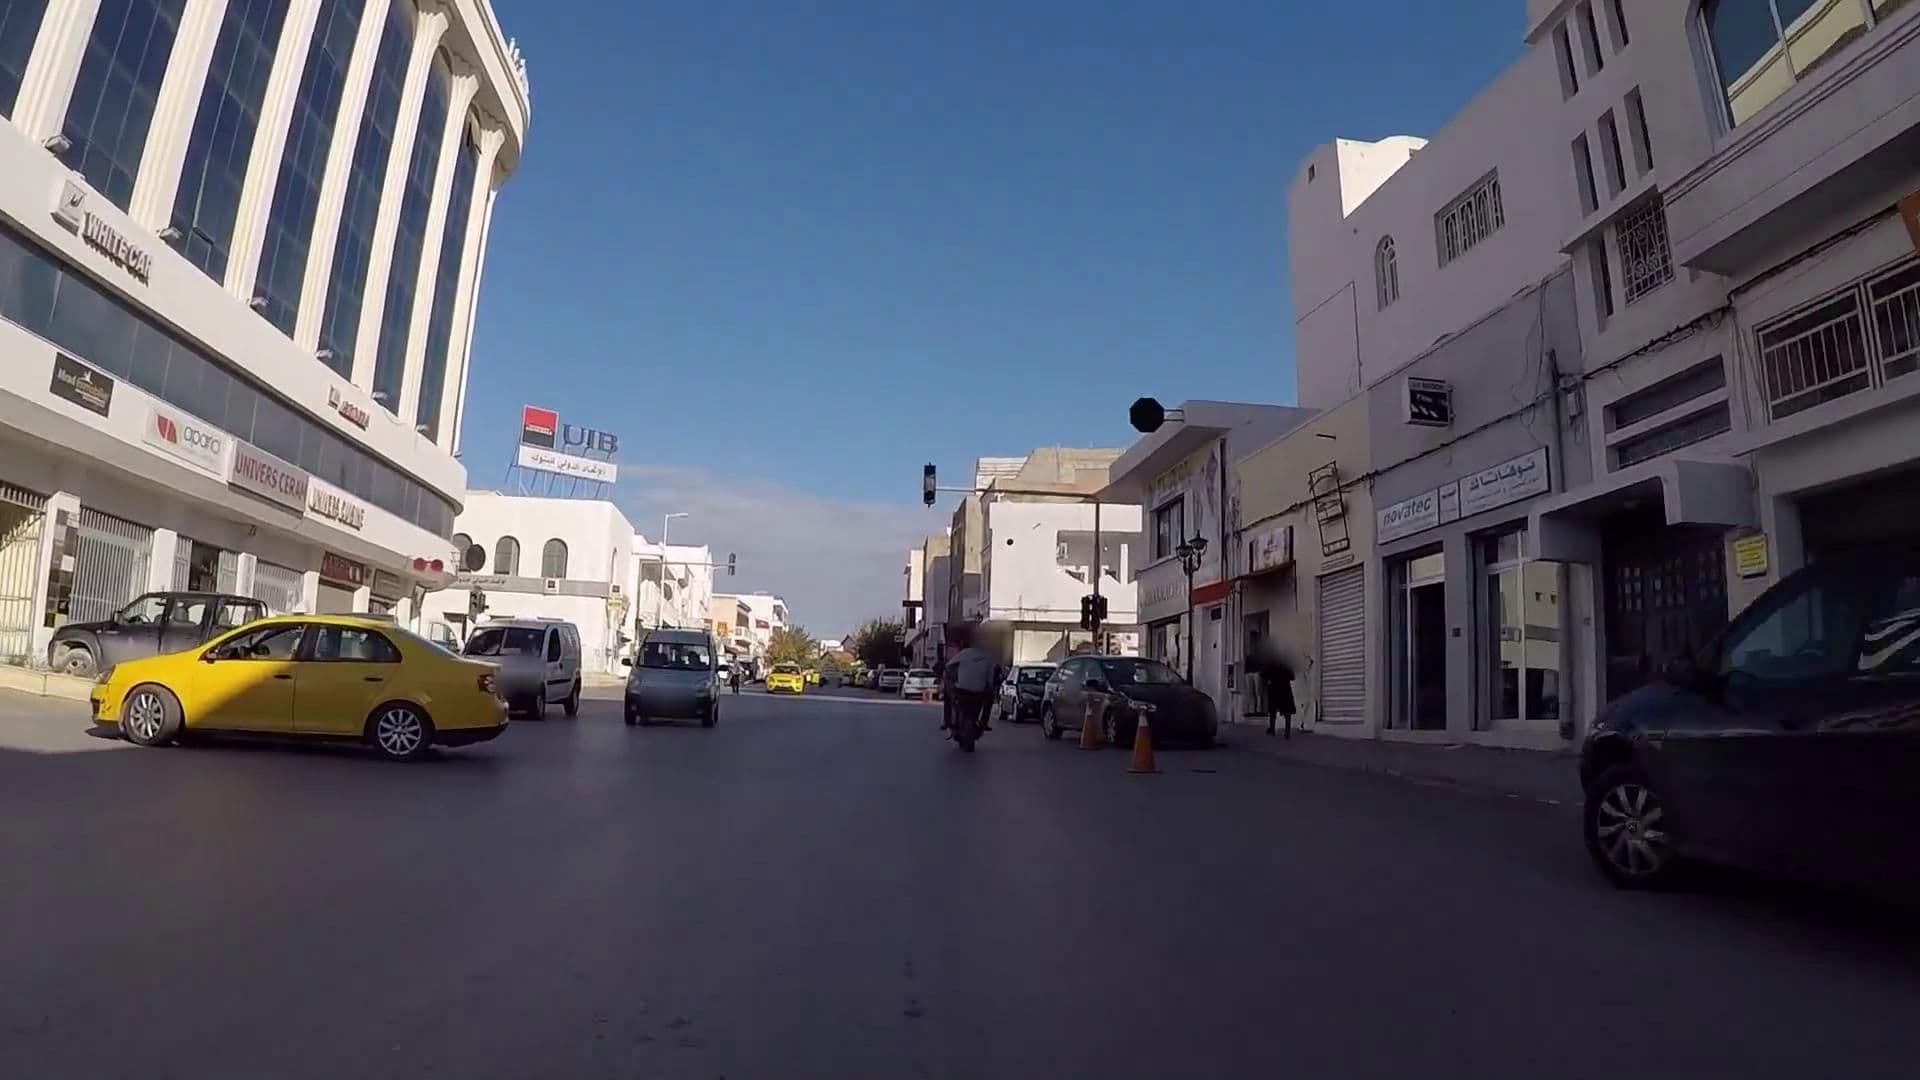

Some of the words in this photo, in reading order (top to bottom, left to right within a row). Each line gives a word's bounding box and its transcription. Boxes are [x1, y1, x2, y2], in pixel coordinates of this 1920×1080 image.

[563, 424, 618, 453] UIB
[235, 452, 277, 489] UNIVERS
[1383, 497, 1432, 526] novatec
